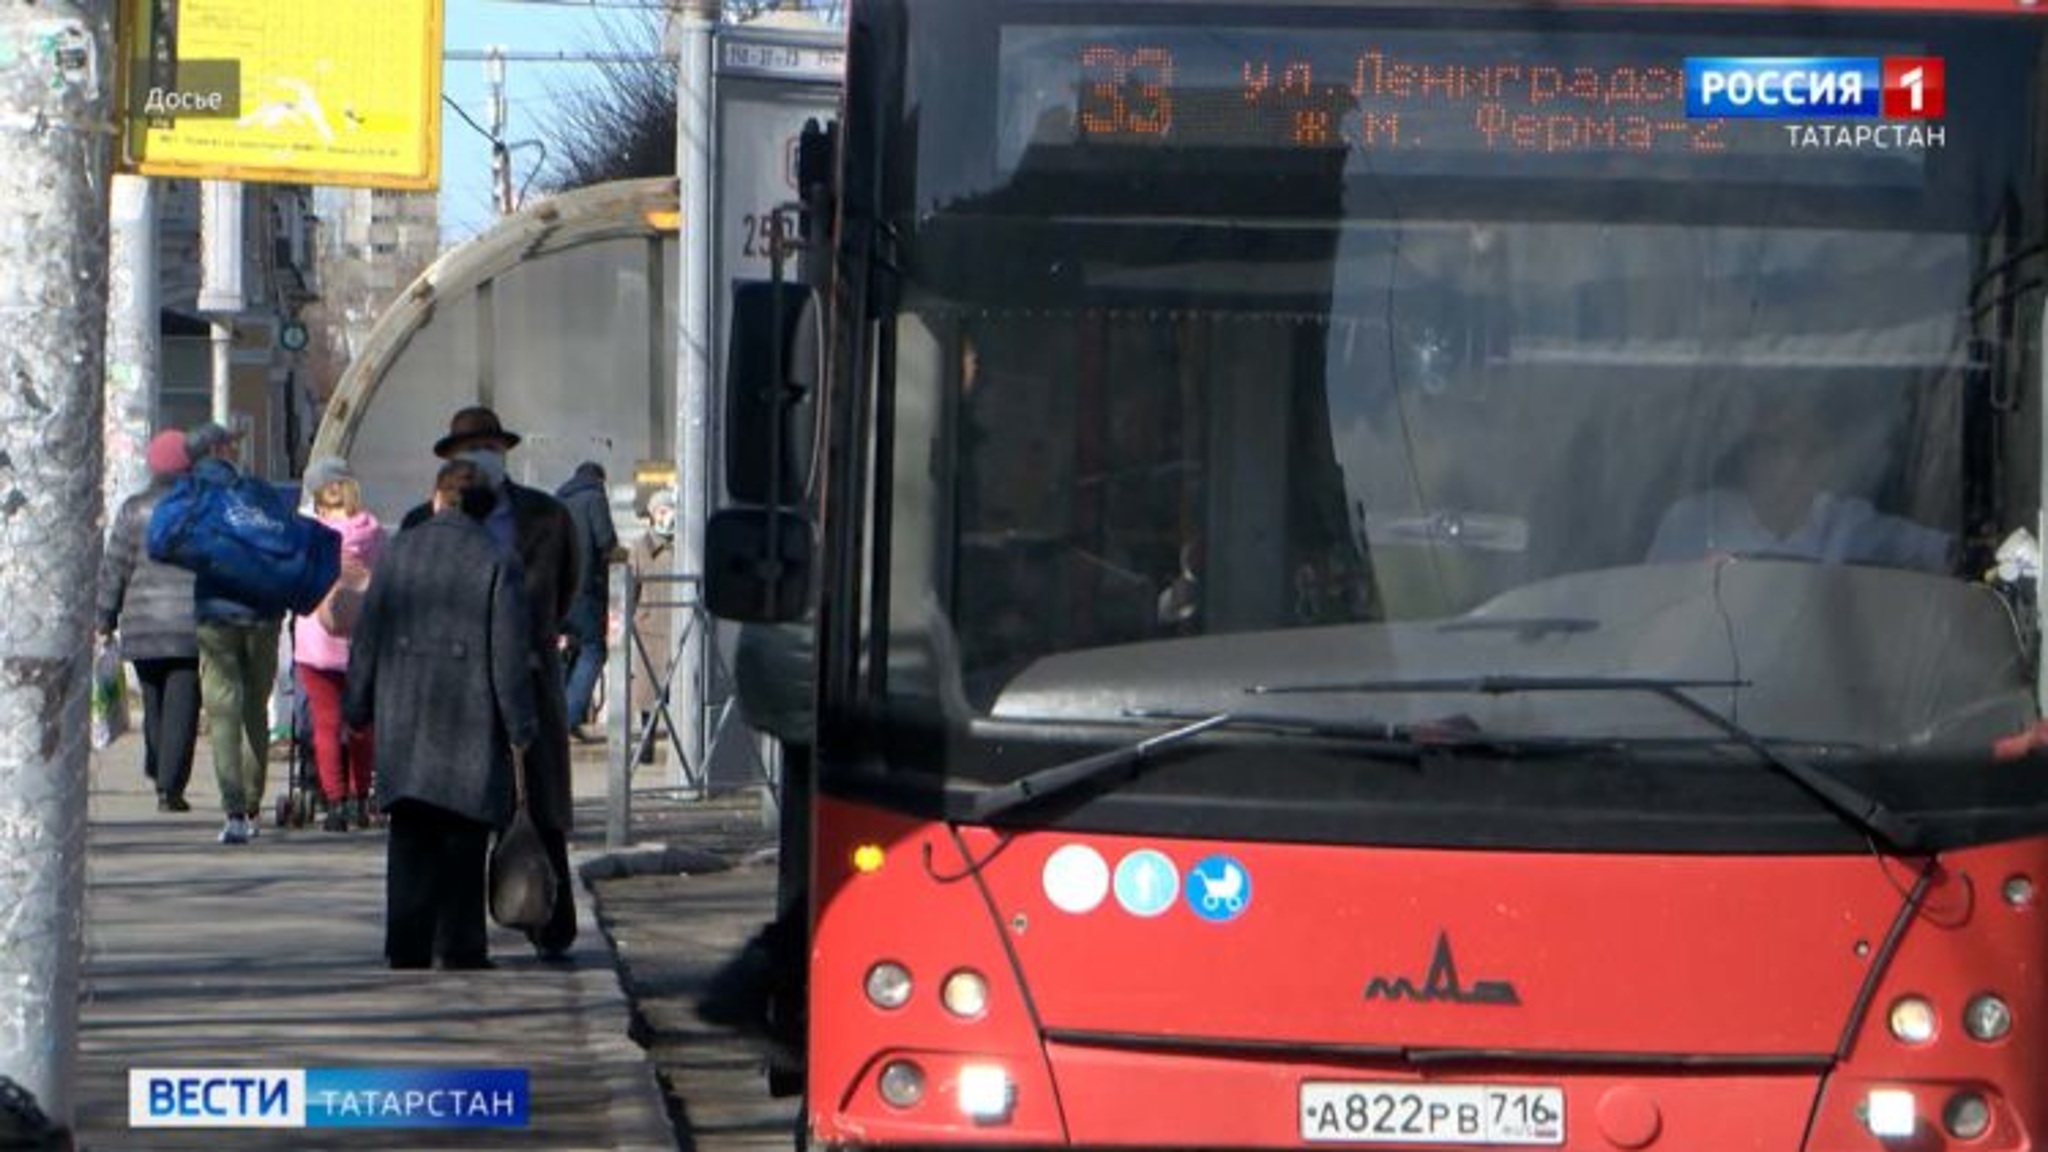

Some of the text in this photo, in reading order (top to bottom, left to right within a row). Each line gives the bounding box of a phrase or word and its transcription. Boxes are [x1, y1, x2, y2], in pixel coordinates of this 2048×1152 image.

[1080, 44, 1172, 135] 33
[1243, 50, 1685, 104] ул.Лениградс
[1489, 1092, 1551, 1126] 716
